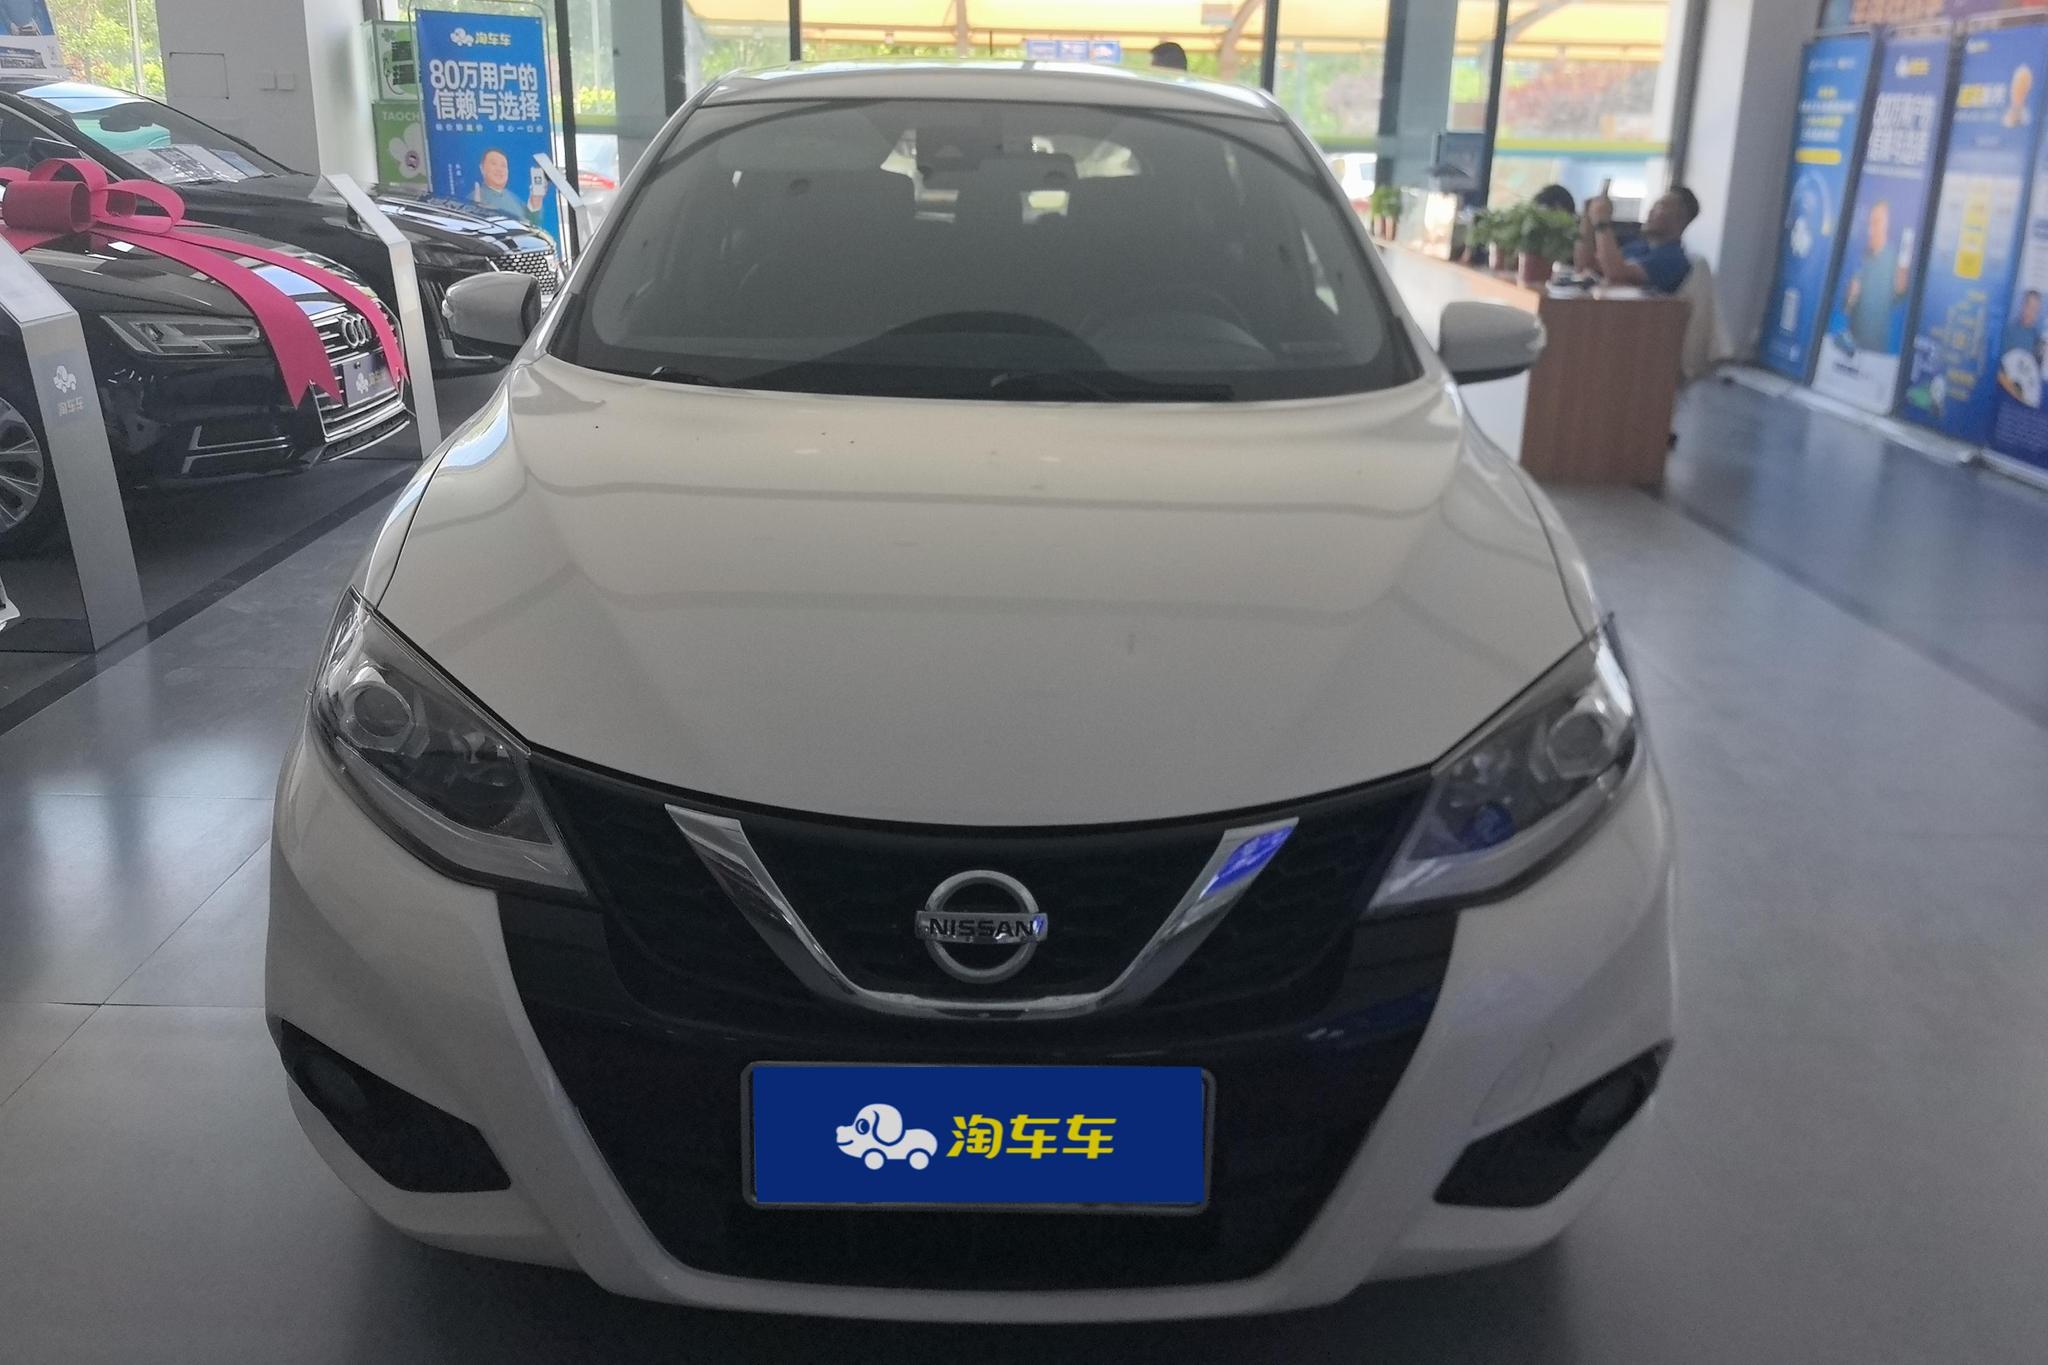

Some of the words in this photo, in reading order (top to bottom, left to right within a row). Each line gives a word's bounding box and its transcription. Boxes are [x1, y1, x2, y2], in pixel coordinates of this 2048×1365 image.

[475, 32, 512, 46] 淘车车
[429, 59, 538, 91] 80万用户的
[433, 89, 541, 121] 信赖与选择
[929, 918, 1035, 938] NISSAN
